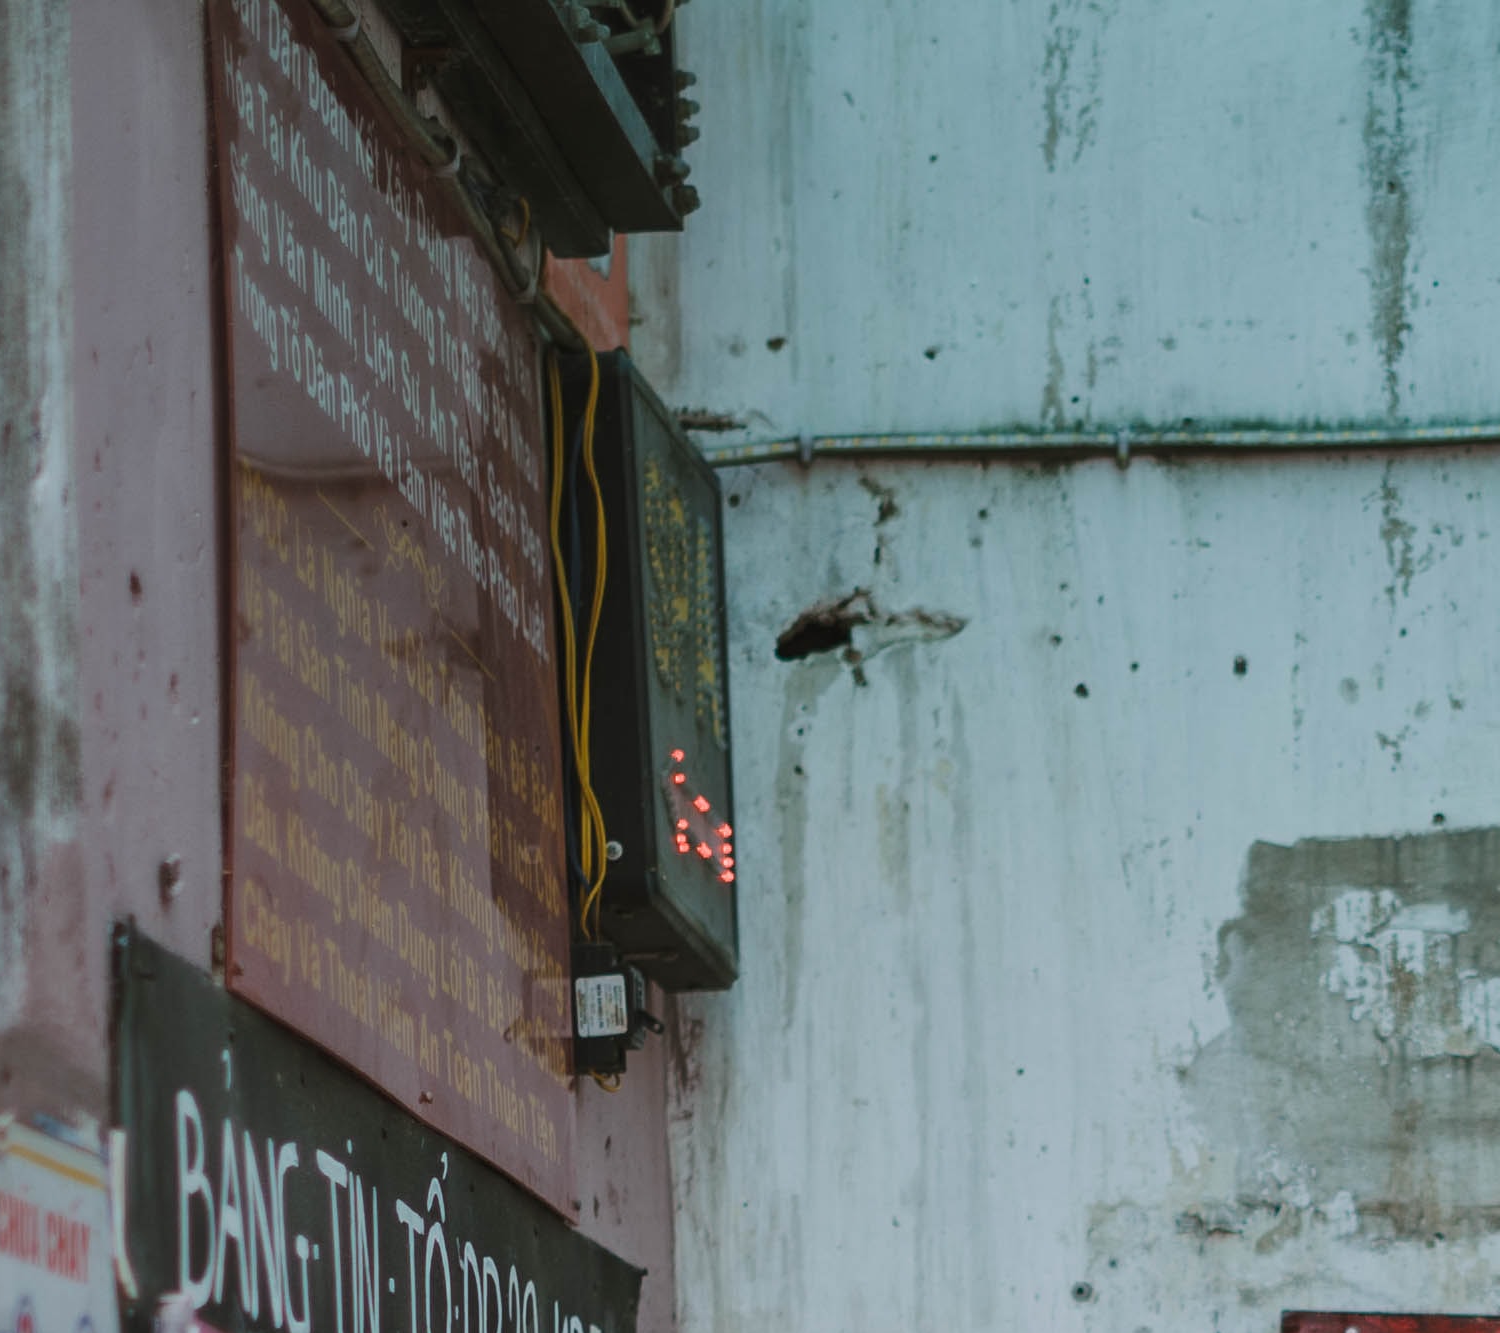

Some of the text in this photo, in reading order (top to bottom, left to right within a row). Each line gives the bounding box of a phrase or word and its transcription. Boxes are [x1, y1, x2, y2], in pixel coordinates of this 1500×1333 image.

[289, 120, 323, 220] Khu
[326, 162, 358, 261] Dân
[235, 243, 278, 373] Trong
[280, 301, 301, 385] Tổ
[304, 332, 336, 424] Dân
[340, 370, 370, 460] Phố
[373, 407, 393, 485] Và
[396, 432, 426, 522] Làm
[428, 470, 456, 558] Việc
[458, 506, 487, 594] Theo
[363, 303, 396, 398] Lịch
[428, 381, 447, 459] An
